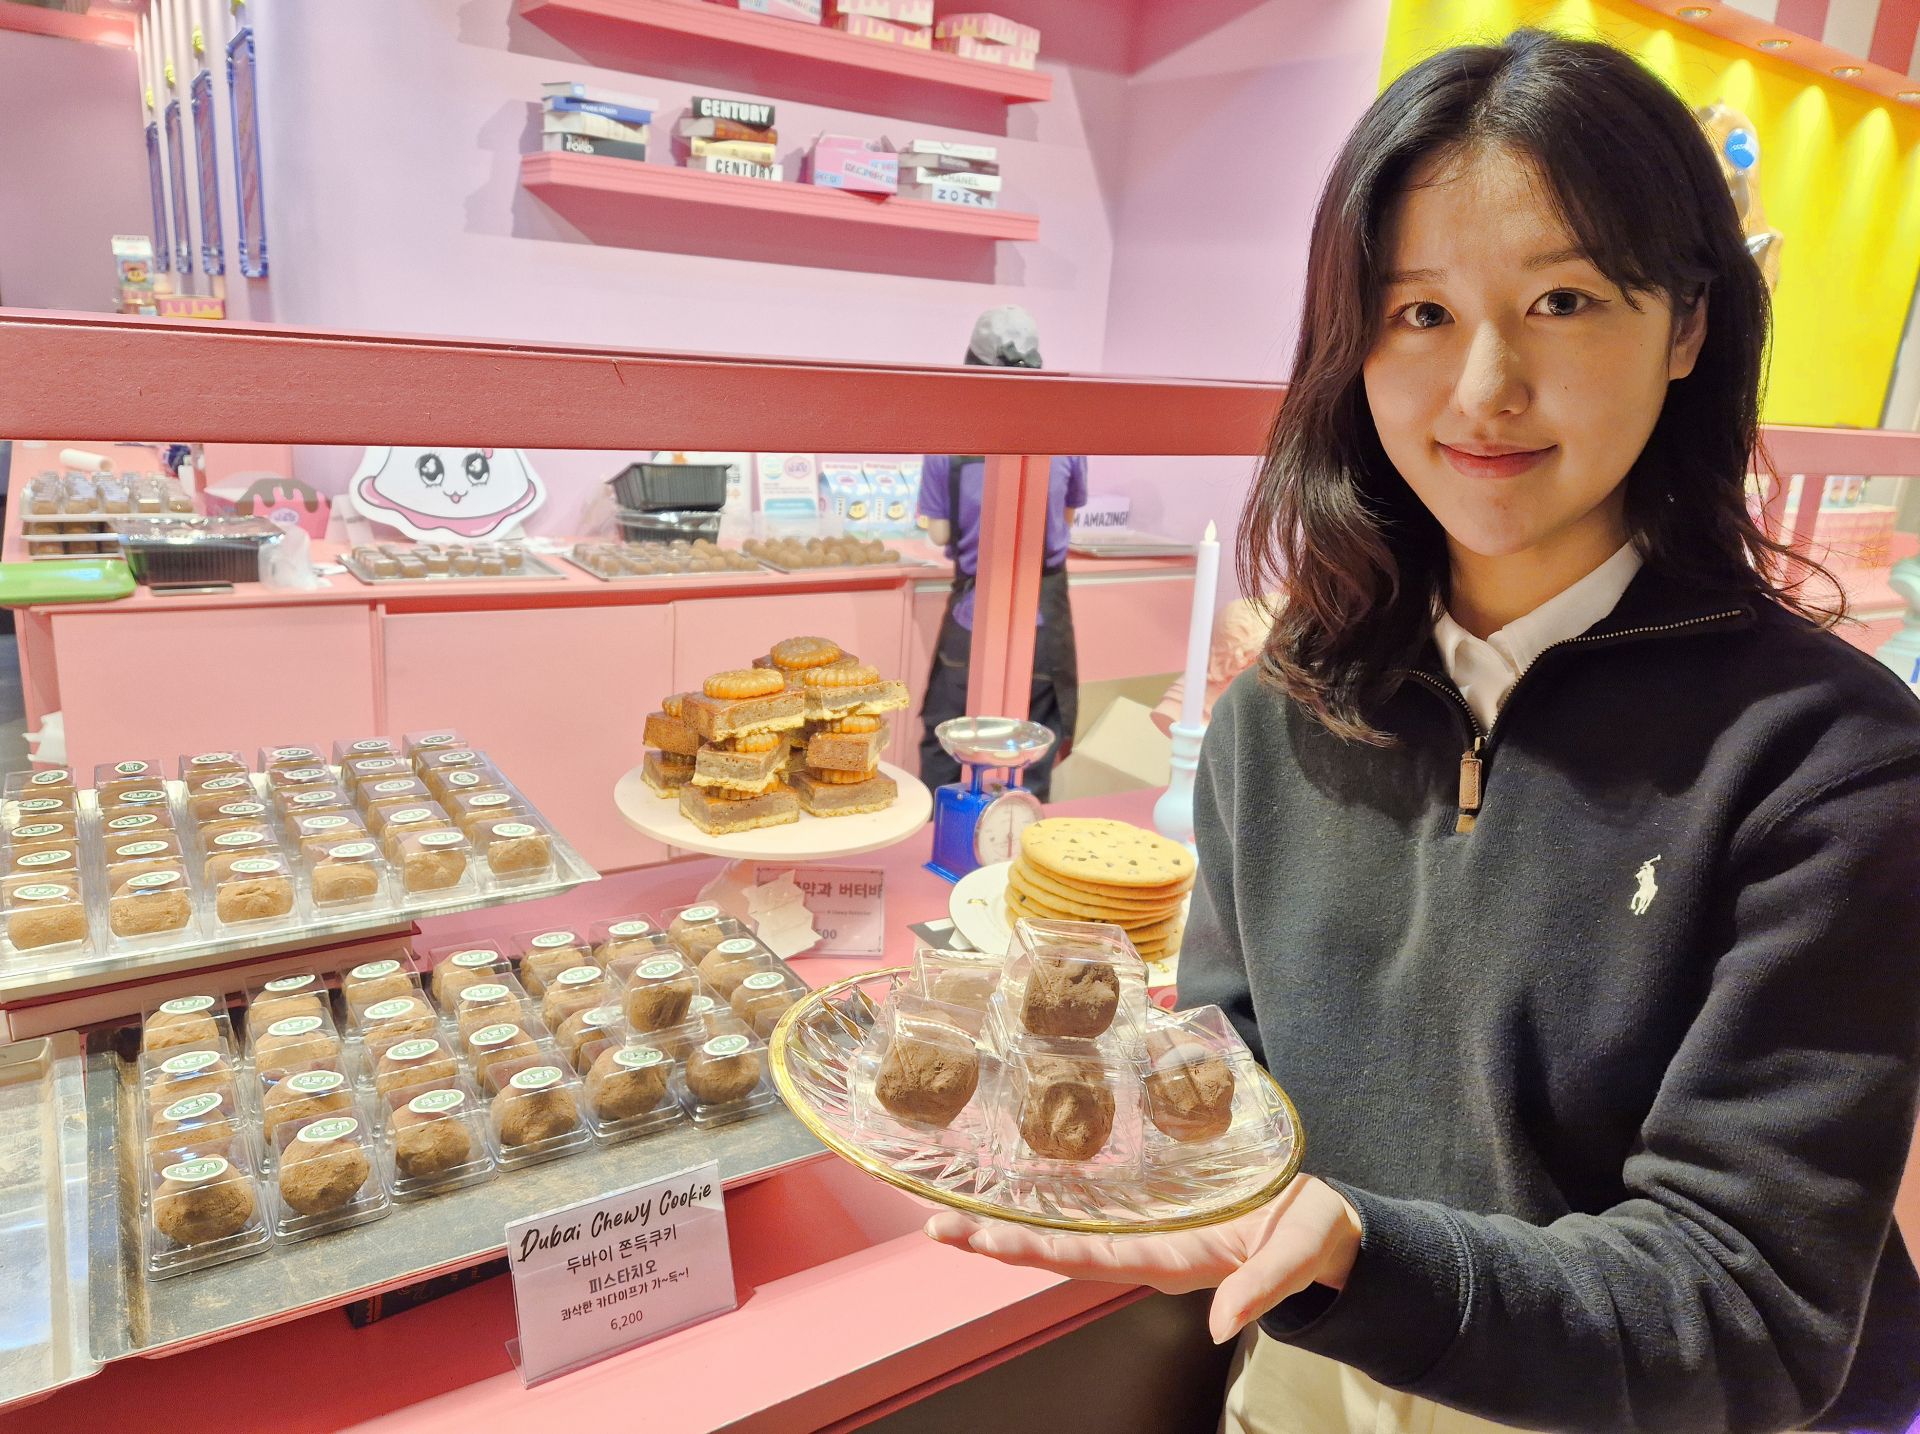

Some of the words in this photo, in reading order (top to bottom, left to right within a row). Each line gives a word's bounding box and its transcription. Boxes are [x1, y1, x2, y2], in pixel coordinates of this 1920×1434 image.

[700, 98, 770, 123] CENTURY
[715, 159, 774, 180] CENTURY
[839, 883, 882, 898] 버터바
[517, 1223, 582, 1263] Dubai
[591, 1199, 651, 1238] Chewy
[659, 1183, 711, 1216] Cookie
[566, 1245, 613, 1275] 두바이
[588, 1259, 658, 1294] 피스타치오
[595, 1282, 649, 1309] 카다이프가
[610, 1310, 643, 1331] 6,200
